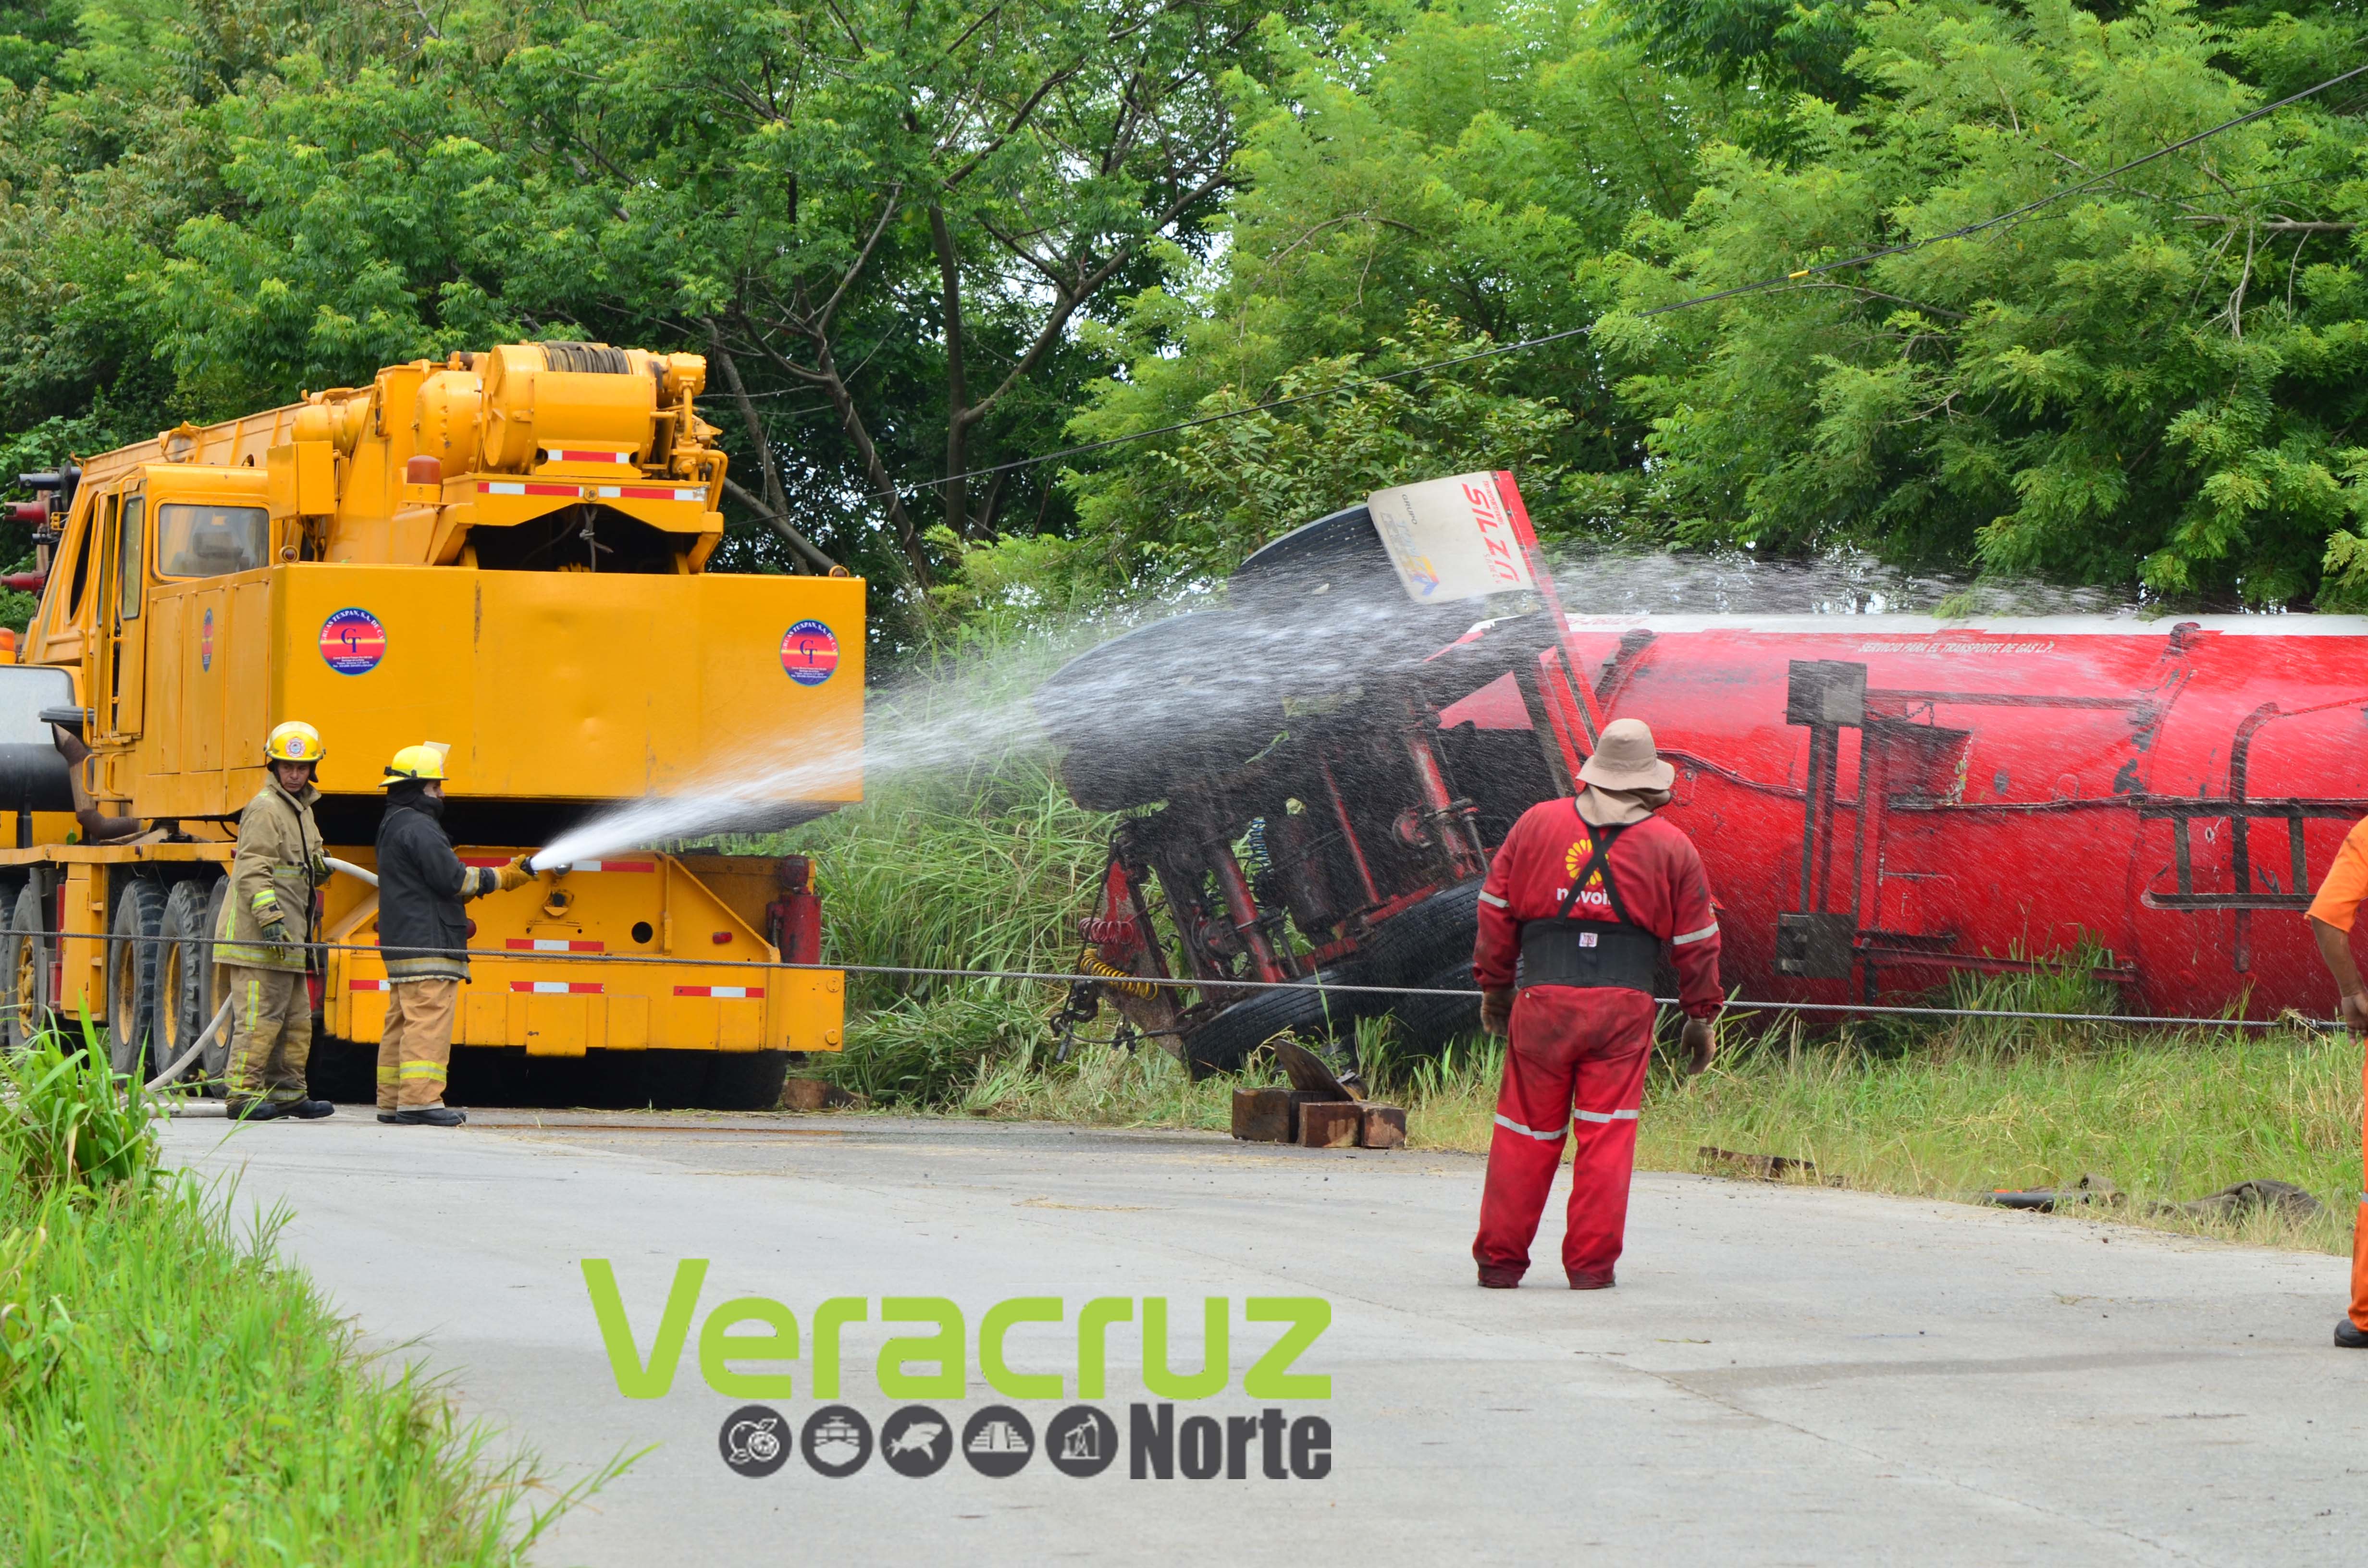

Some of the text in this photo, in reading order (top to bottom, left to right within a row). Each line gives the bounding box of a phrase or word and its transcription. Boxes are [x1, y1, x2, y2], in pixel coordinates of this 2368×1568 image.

[1402, 494, 1418, 525] GRUPO
[1462, 483, 1520, 583] SILZA
[370, 620, 380, 629] DE
[1858, 642, 1904, 652] SERVICIO
[1900, 642, 1929, 652] PARA
[1927, 642, 1941, 652] EL
[1940, 642, 2004, 653] TRANSPORTE
[2000, 643, 2017, 653] DE
[2015, 643, 2039, 653] GAS
